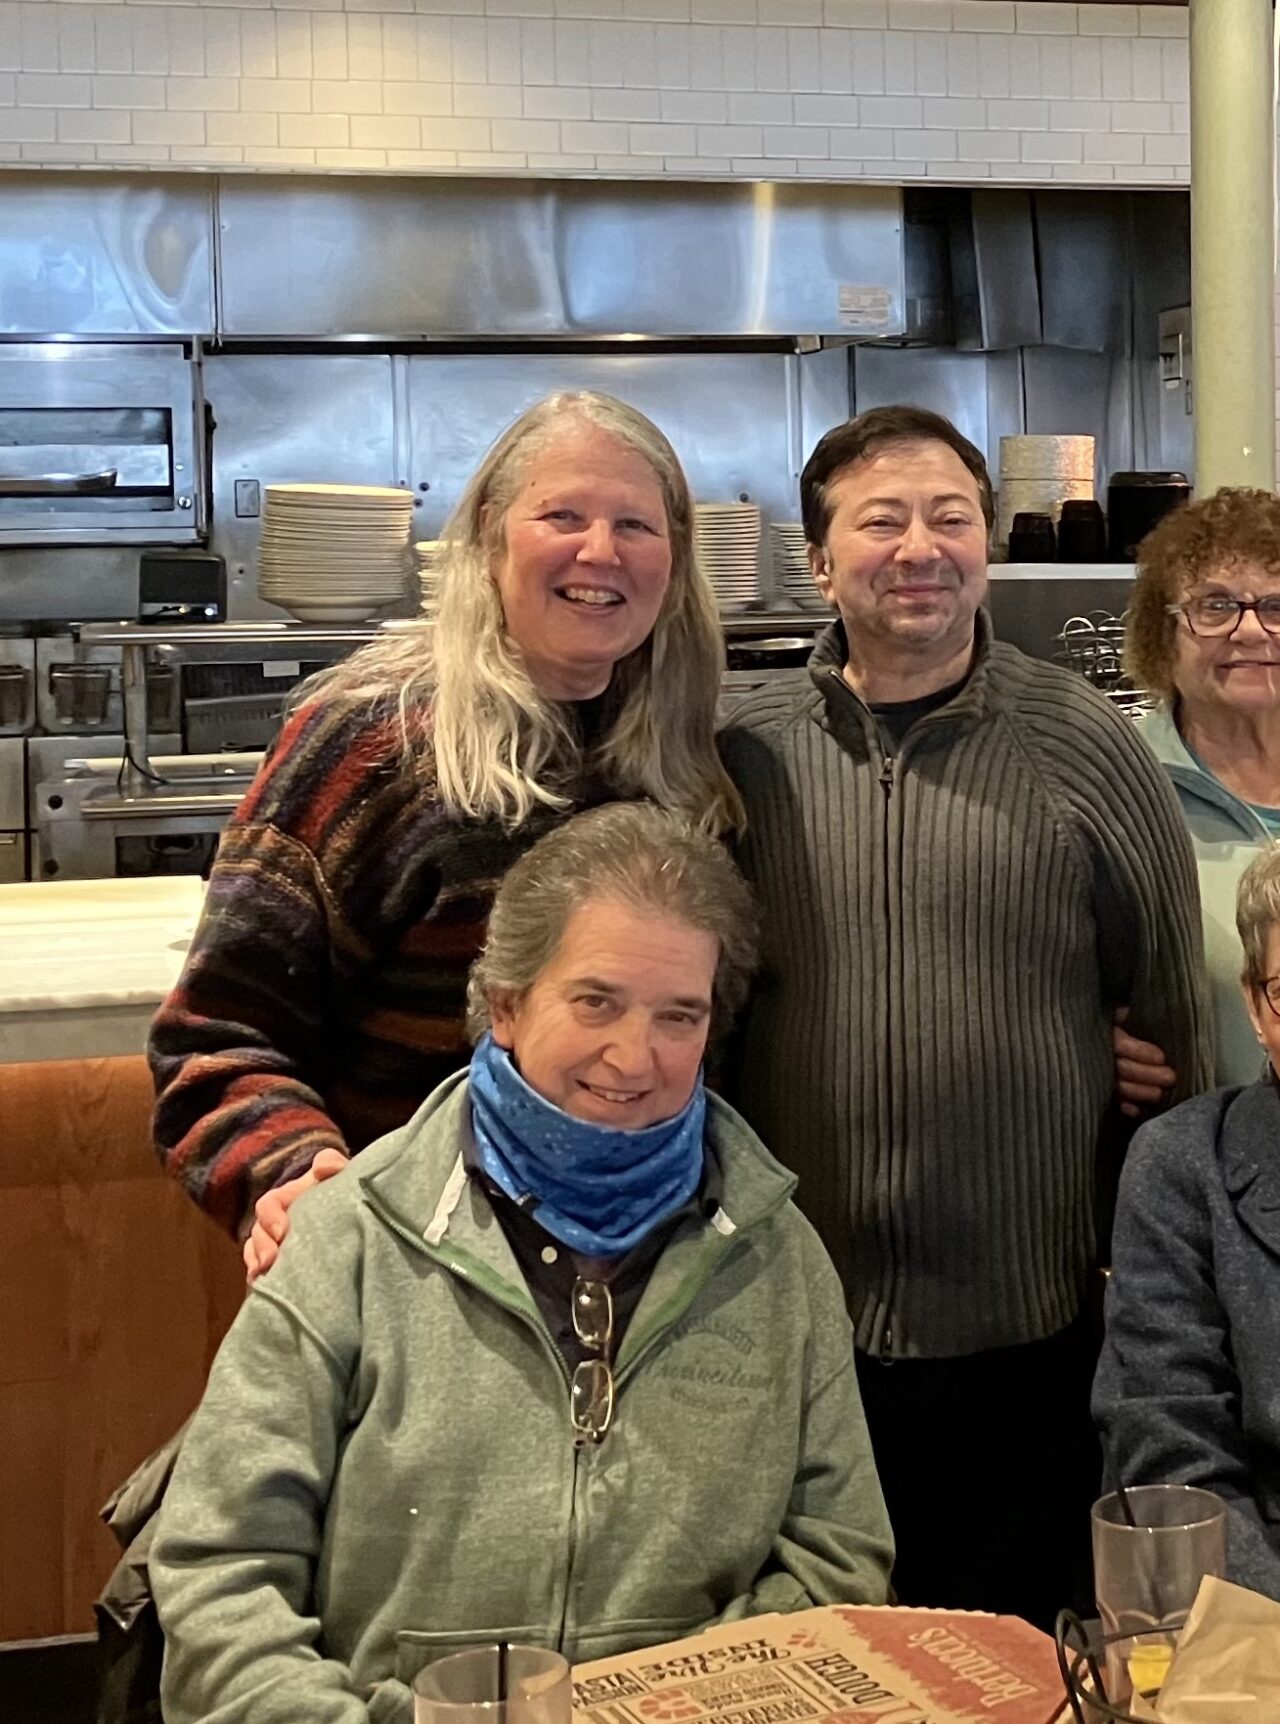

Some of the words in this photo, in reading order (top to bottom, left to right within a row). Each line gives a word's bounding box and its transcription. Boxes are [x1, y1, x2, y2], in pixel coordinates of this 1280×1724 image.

[639, 1638, 768, 1673] INSIDE
[727, 1647, 791, 1664] The
[573, 1672, 634, 1696] ASTA
[803, 1653, 896, 1704] DOUGH
